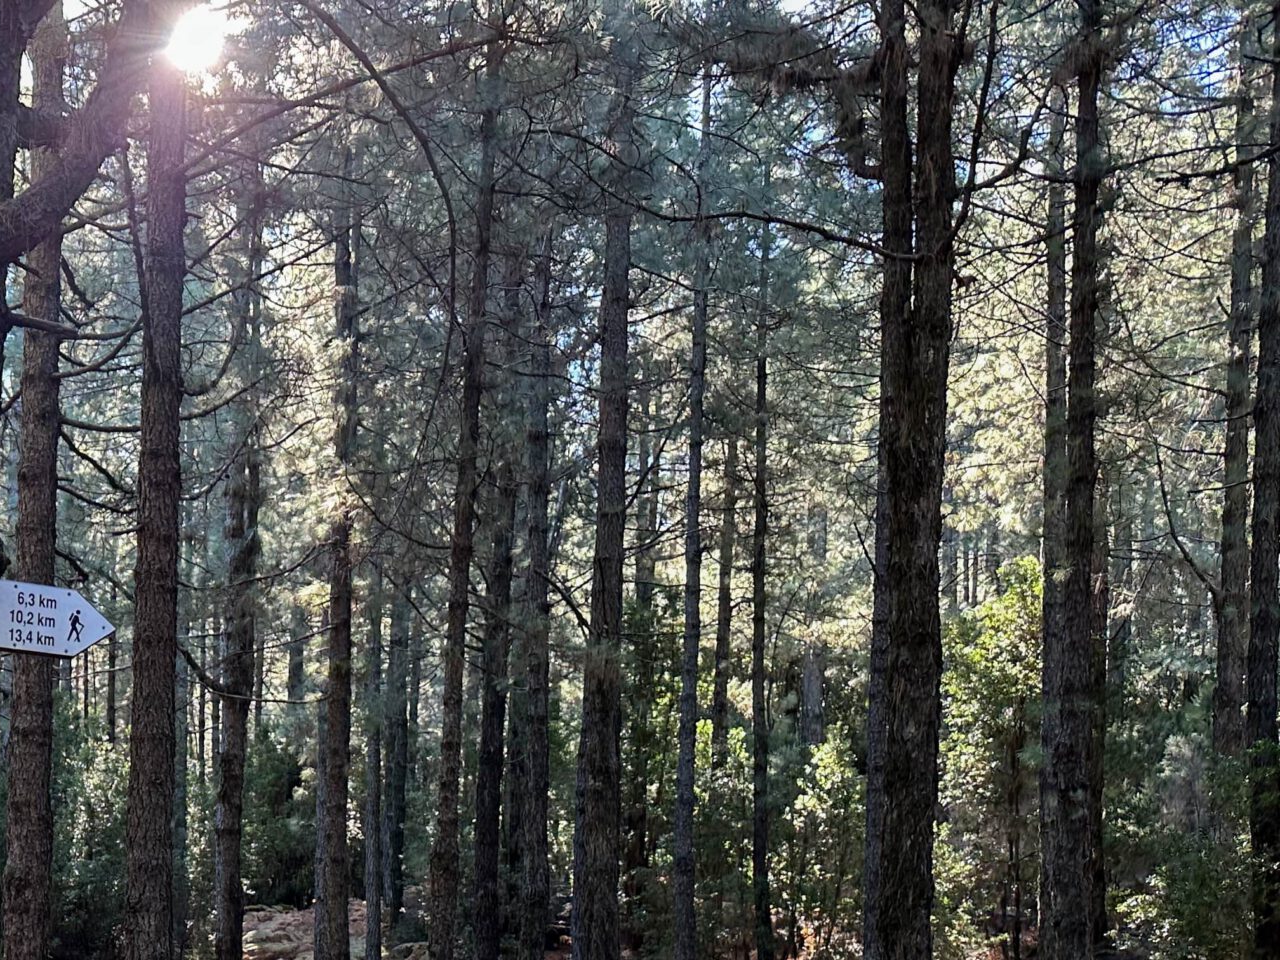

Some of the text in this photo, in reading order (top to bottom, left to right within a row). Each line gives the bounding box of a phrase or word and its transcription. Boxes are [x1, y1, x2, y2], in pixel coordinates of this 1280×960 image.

[17, 591, 35, 608] 6,3
[39, 593, 57, 610] km
[10, 609, 34, 627] 10,2
[37, 612, 56, 628] km
[9, 628, 33, 645] 13,4
[36, 630, 55, 647] km
